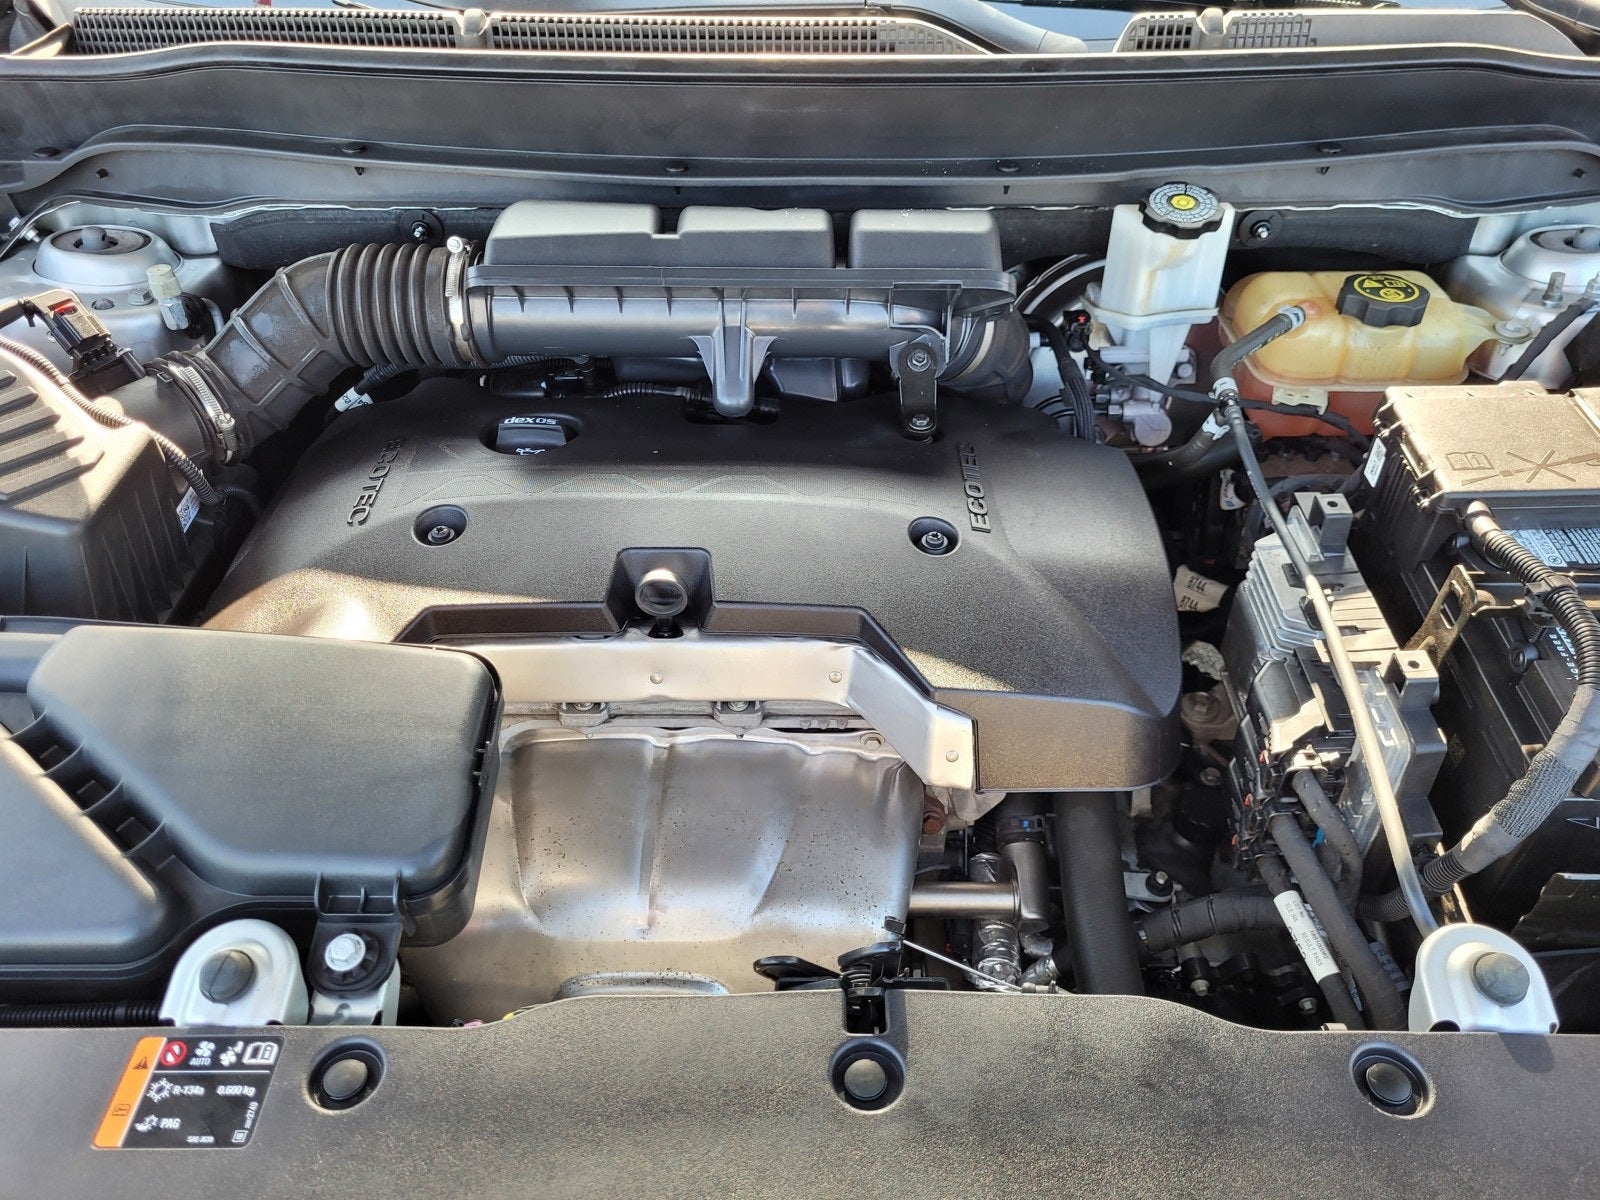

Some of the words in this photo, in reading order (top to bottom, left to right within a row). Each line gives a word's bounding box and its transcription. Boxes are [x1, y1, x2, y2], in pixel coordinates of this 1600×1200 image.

[503, 416, 558, 425] dexos
[347, 440, 401, 526] ECOTEC
[957, 442, 991, 533] ECOTEC
[189, 1057, 212, 1066] AUTO
[172, 1085, 205, 1096] R-134a
[216, 1085, 241, 1096] 0.600
[242, 1086, 256, 1098] kg
[160, 1117, 181, 1129] PAG
